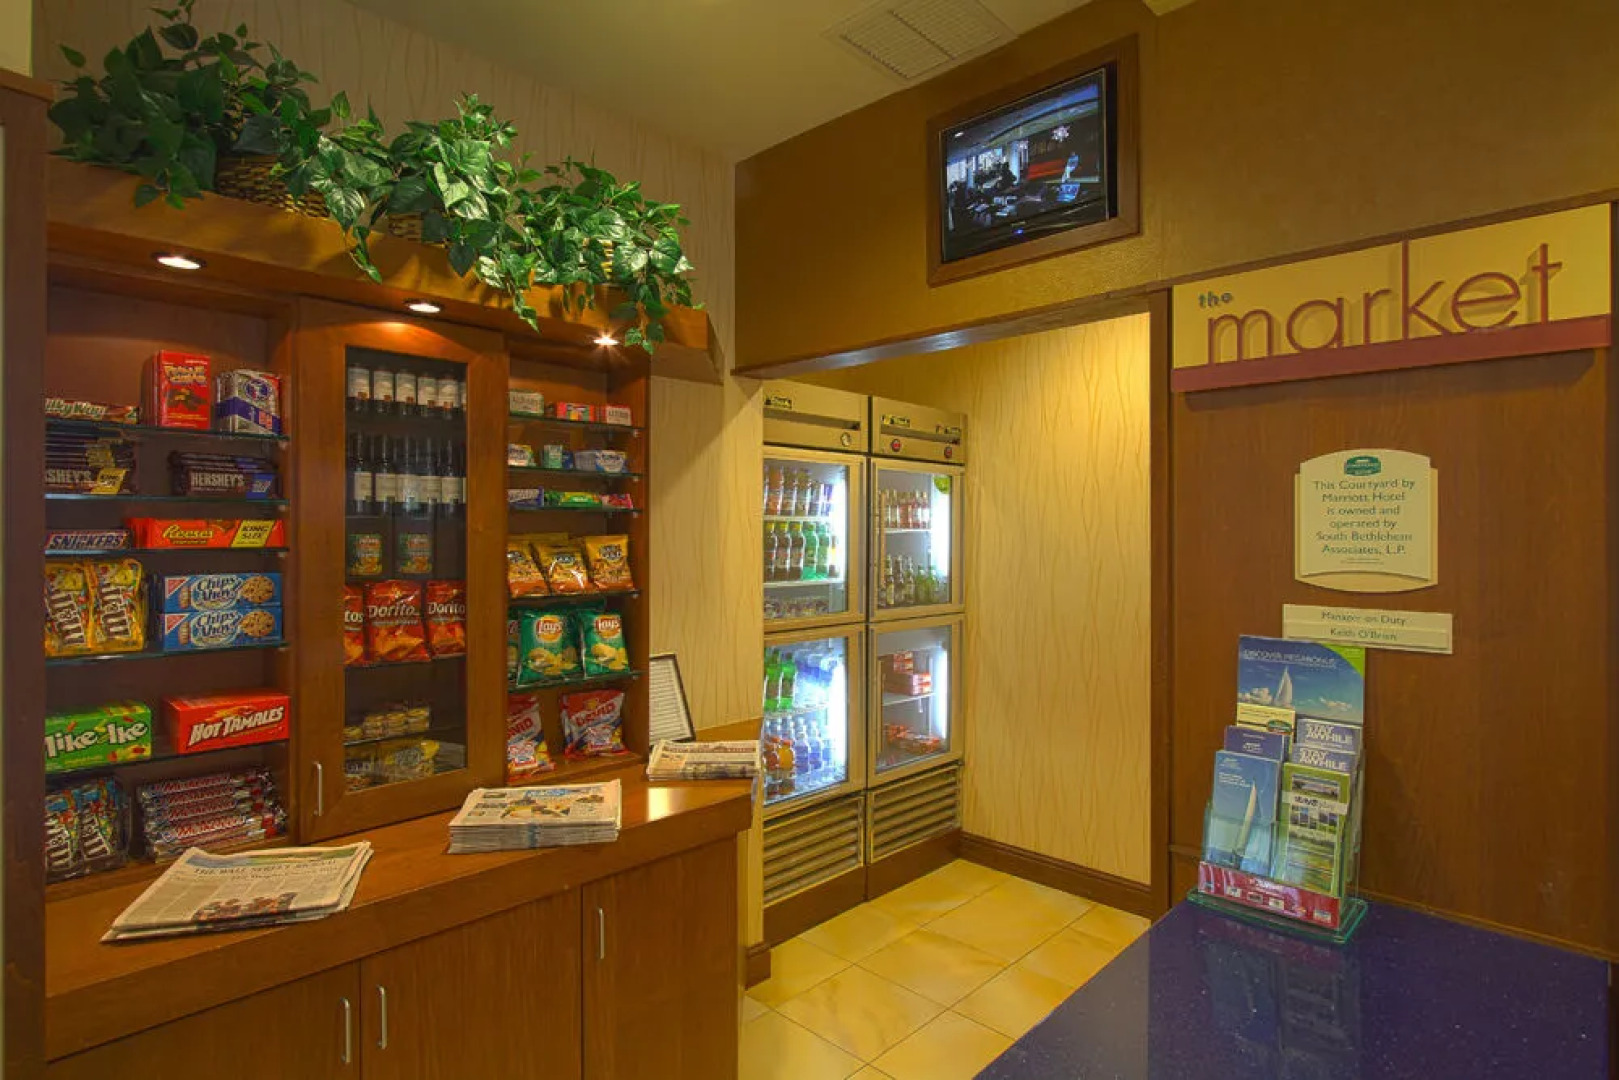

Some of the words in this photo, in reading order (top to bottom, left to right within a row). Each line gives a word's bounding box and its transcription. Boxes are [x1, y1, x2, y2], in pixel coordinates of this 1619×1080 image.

[1198, 291, 1234, 309] the
[1207, 240, 1563, 367] market
[191, 471, 245, 488] HERSHEY'S
[1314, 480, 1335, 490] This
[1338, 478, 1399, 491] Courtyard
[1401, 478, 1416, 490] by
[1322, 492, 1369, 502] Marriott
[1372, 491, 1406, 502] Hotel
[1327, 506, 1335, 515] is
[1338, 505, 1377, 515] owned
[1379, 505, 1401, 515] and
[1328, 519, 1380, 530] operated
[1383, 519, 1398, 530] by
[48, 534, 124, 550] SNICKERS
[1315, 531, 1348, 541] South
[1351, 531, 1413, 541] Bethlehem
[1321, 544, 1382, 555] Associates,
[1321, 611, 1361, 622] Manager
[1380, 615, 1406, 627] Duty
[106, 721, 148, 744] Ike
[188, 722, 222, 747] HOT
[222, 705, 284, 737] TAMALES
